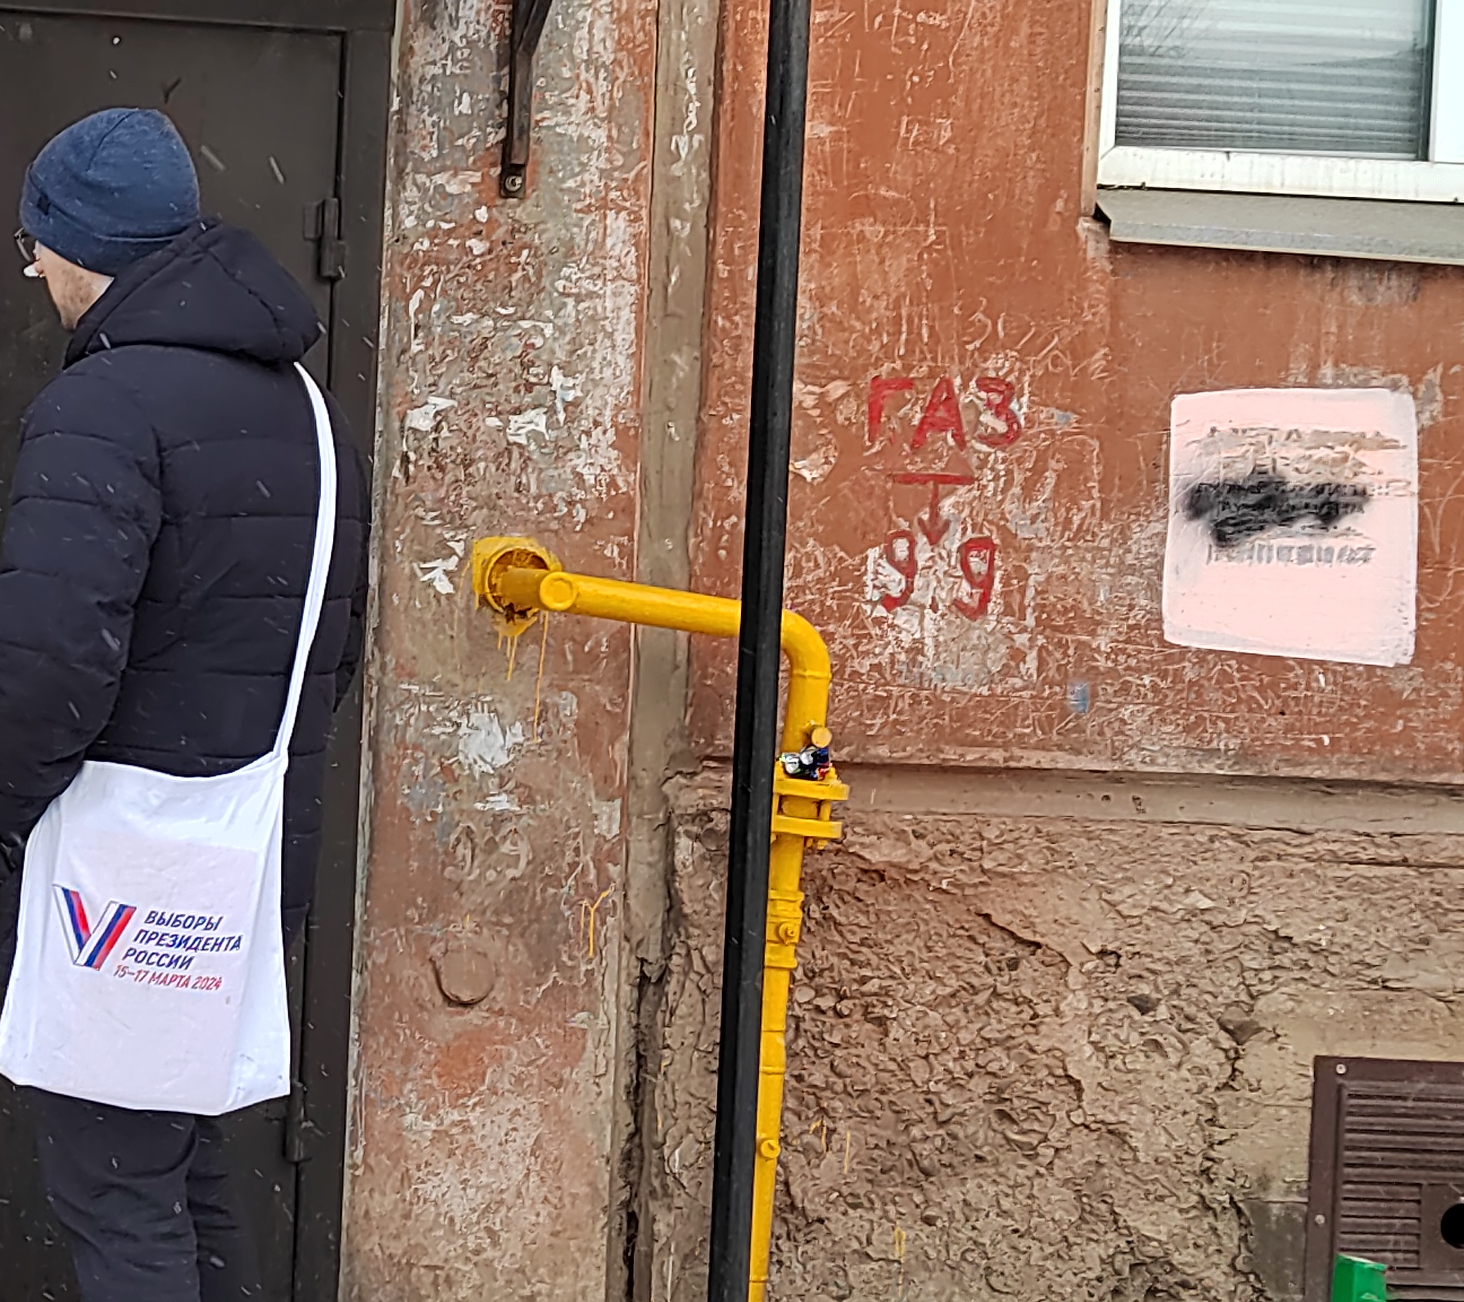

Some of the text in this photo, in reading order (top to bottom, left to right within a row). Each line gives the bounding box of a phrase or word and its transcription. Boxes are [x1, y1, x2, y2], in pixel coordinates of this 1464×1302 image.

[867, 374, 1023, 451] ГАЗ
[144, 910, 224, 932] ВЫБОРЫ
[133, 928, 244, 953] ПРЕЗИДЕНТА
[122, 947, 196, 971] РОССИИ
[148, 971, 191, 989] МАРТА
[191, 976, 223, 991] 2024
